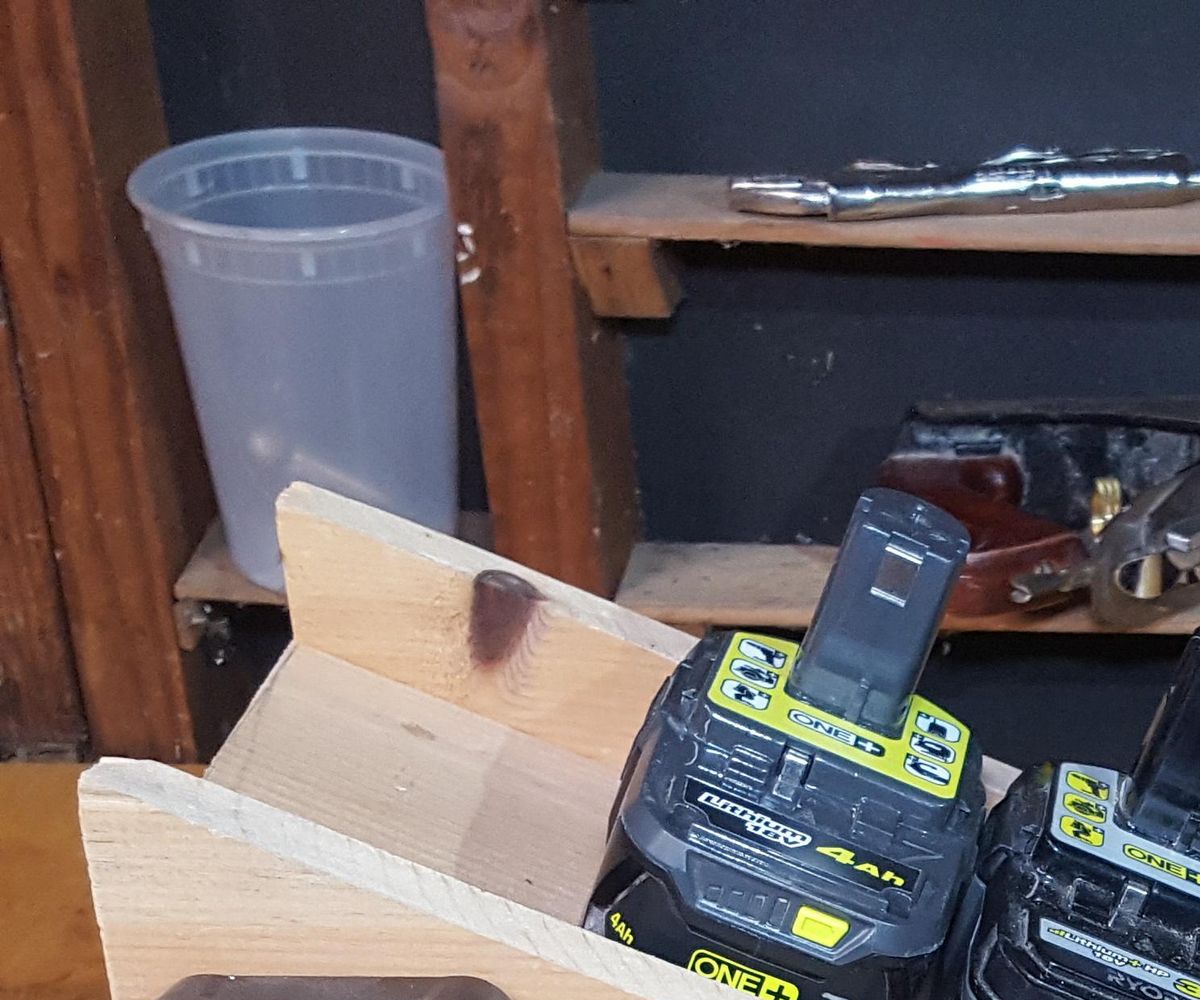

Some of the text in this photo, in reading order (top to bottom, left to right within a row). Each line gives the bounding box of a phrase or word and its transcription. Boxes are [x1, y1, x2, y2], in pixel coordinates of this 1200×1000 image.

[746, 822, 802, 847] 18V
[816, 847, 905, 886] 4Ah
[609, 912, 634, 945] 4Ah
[1143, 963, 1171, 979] HP
